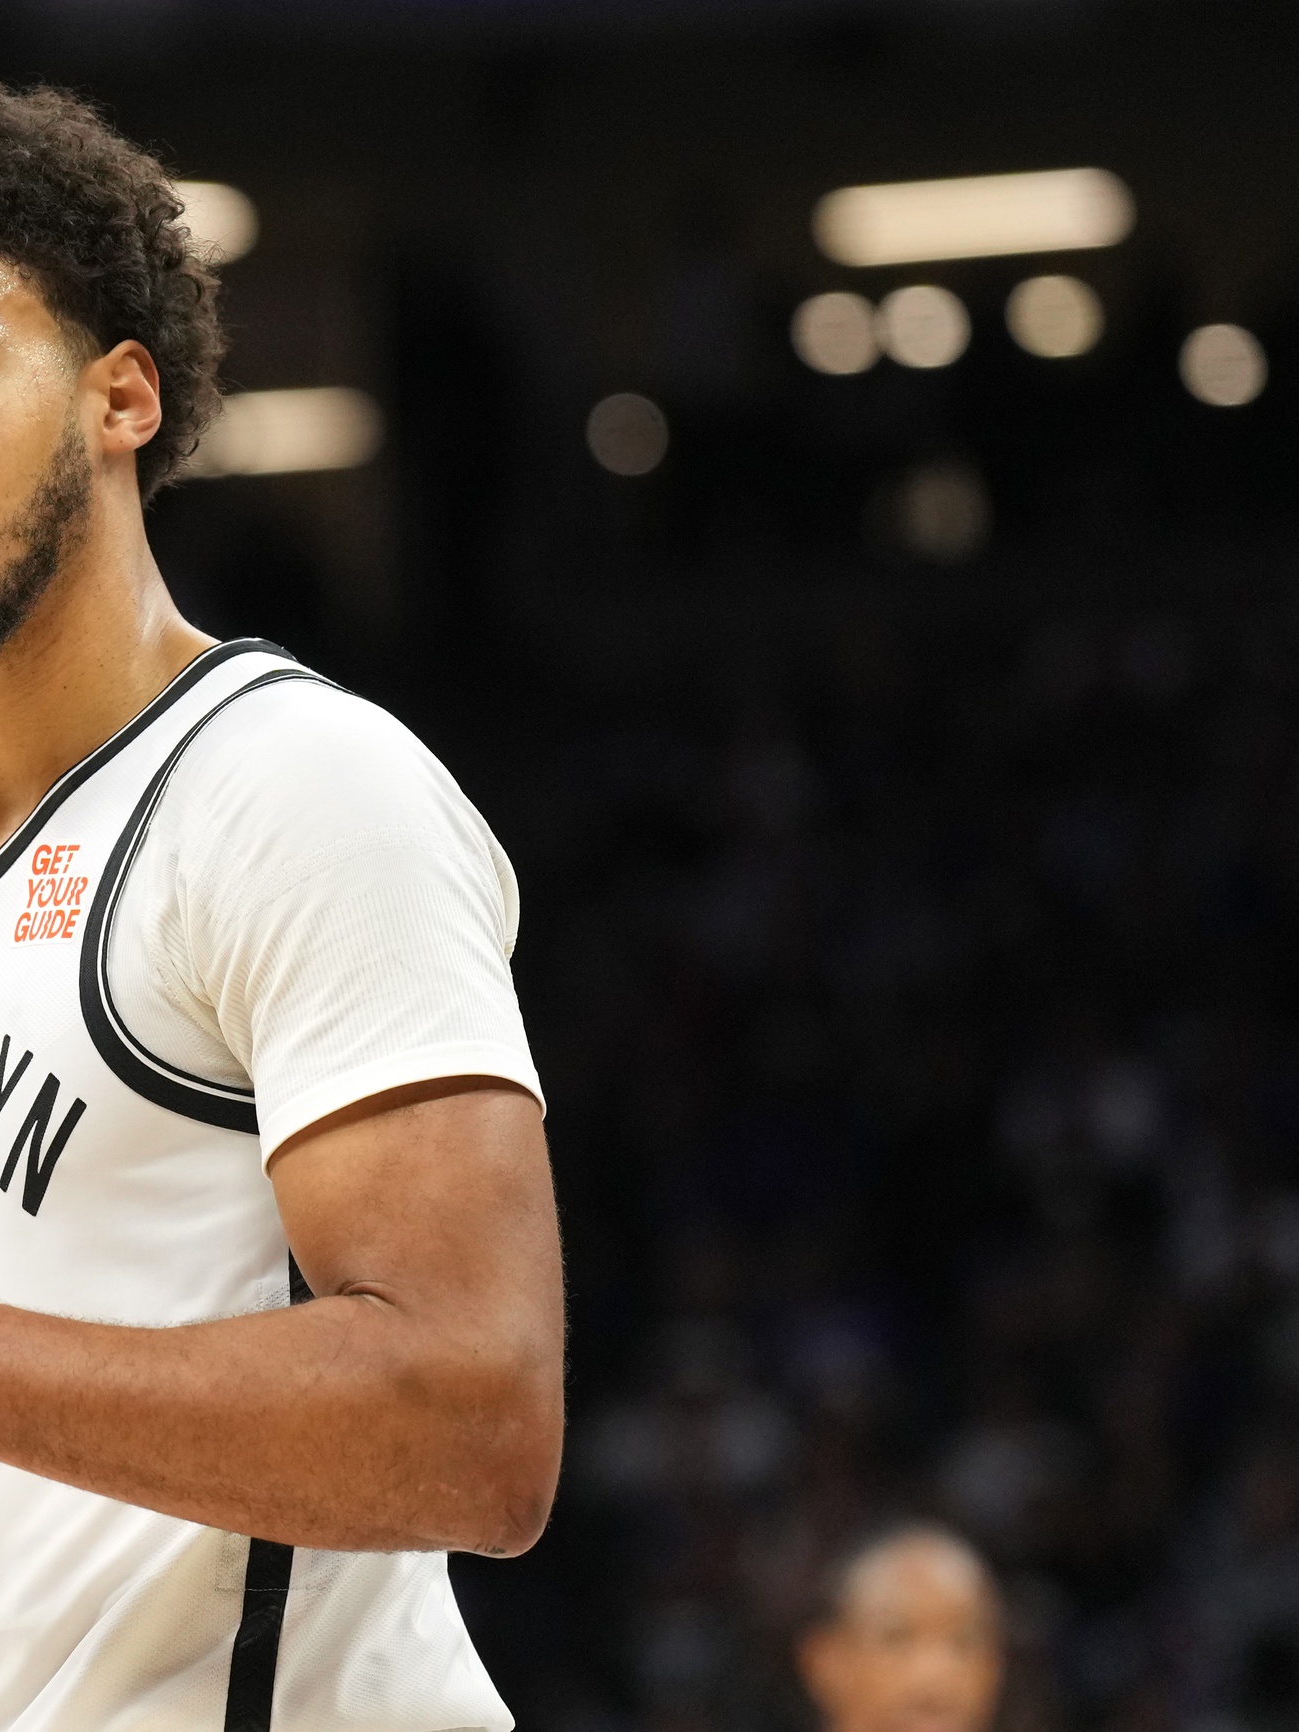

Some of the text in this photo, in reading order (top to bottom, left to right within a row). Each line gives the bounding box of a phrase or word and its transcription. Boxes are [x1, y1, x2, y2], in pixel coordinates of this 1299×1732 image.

[31, 844, 81, 875] GET
[26, 876, 89, 909] YOUR
[14, 909, 81, 943] GUIDE
